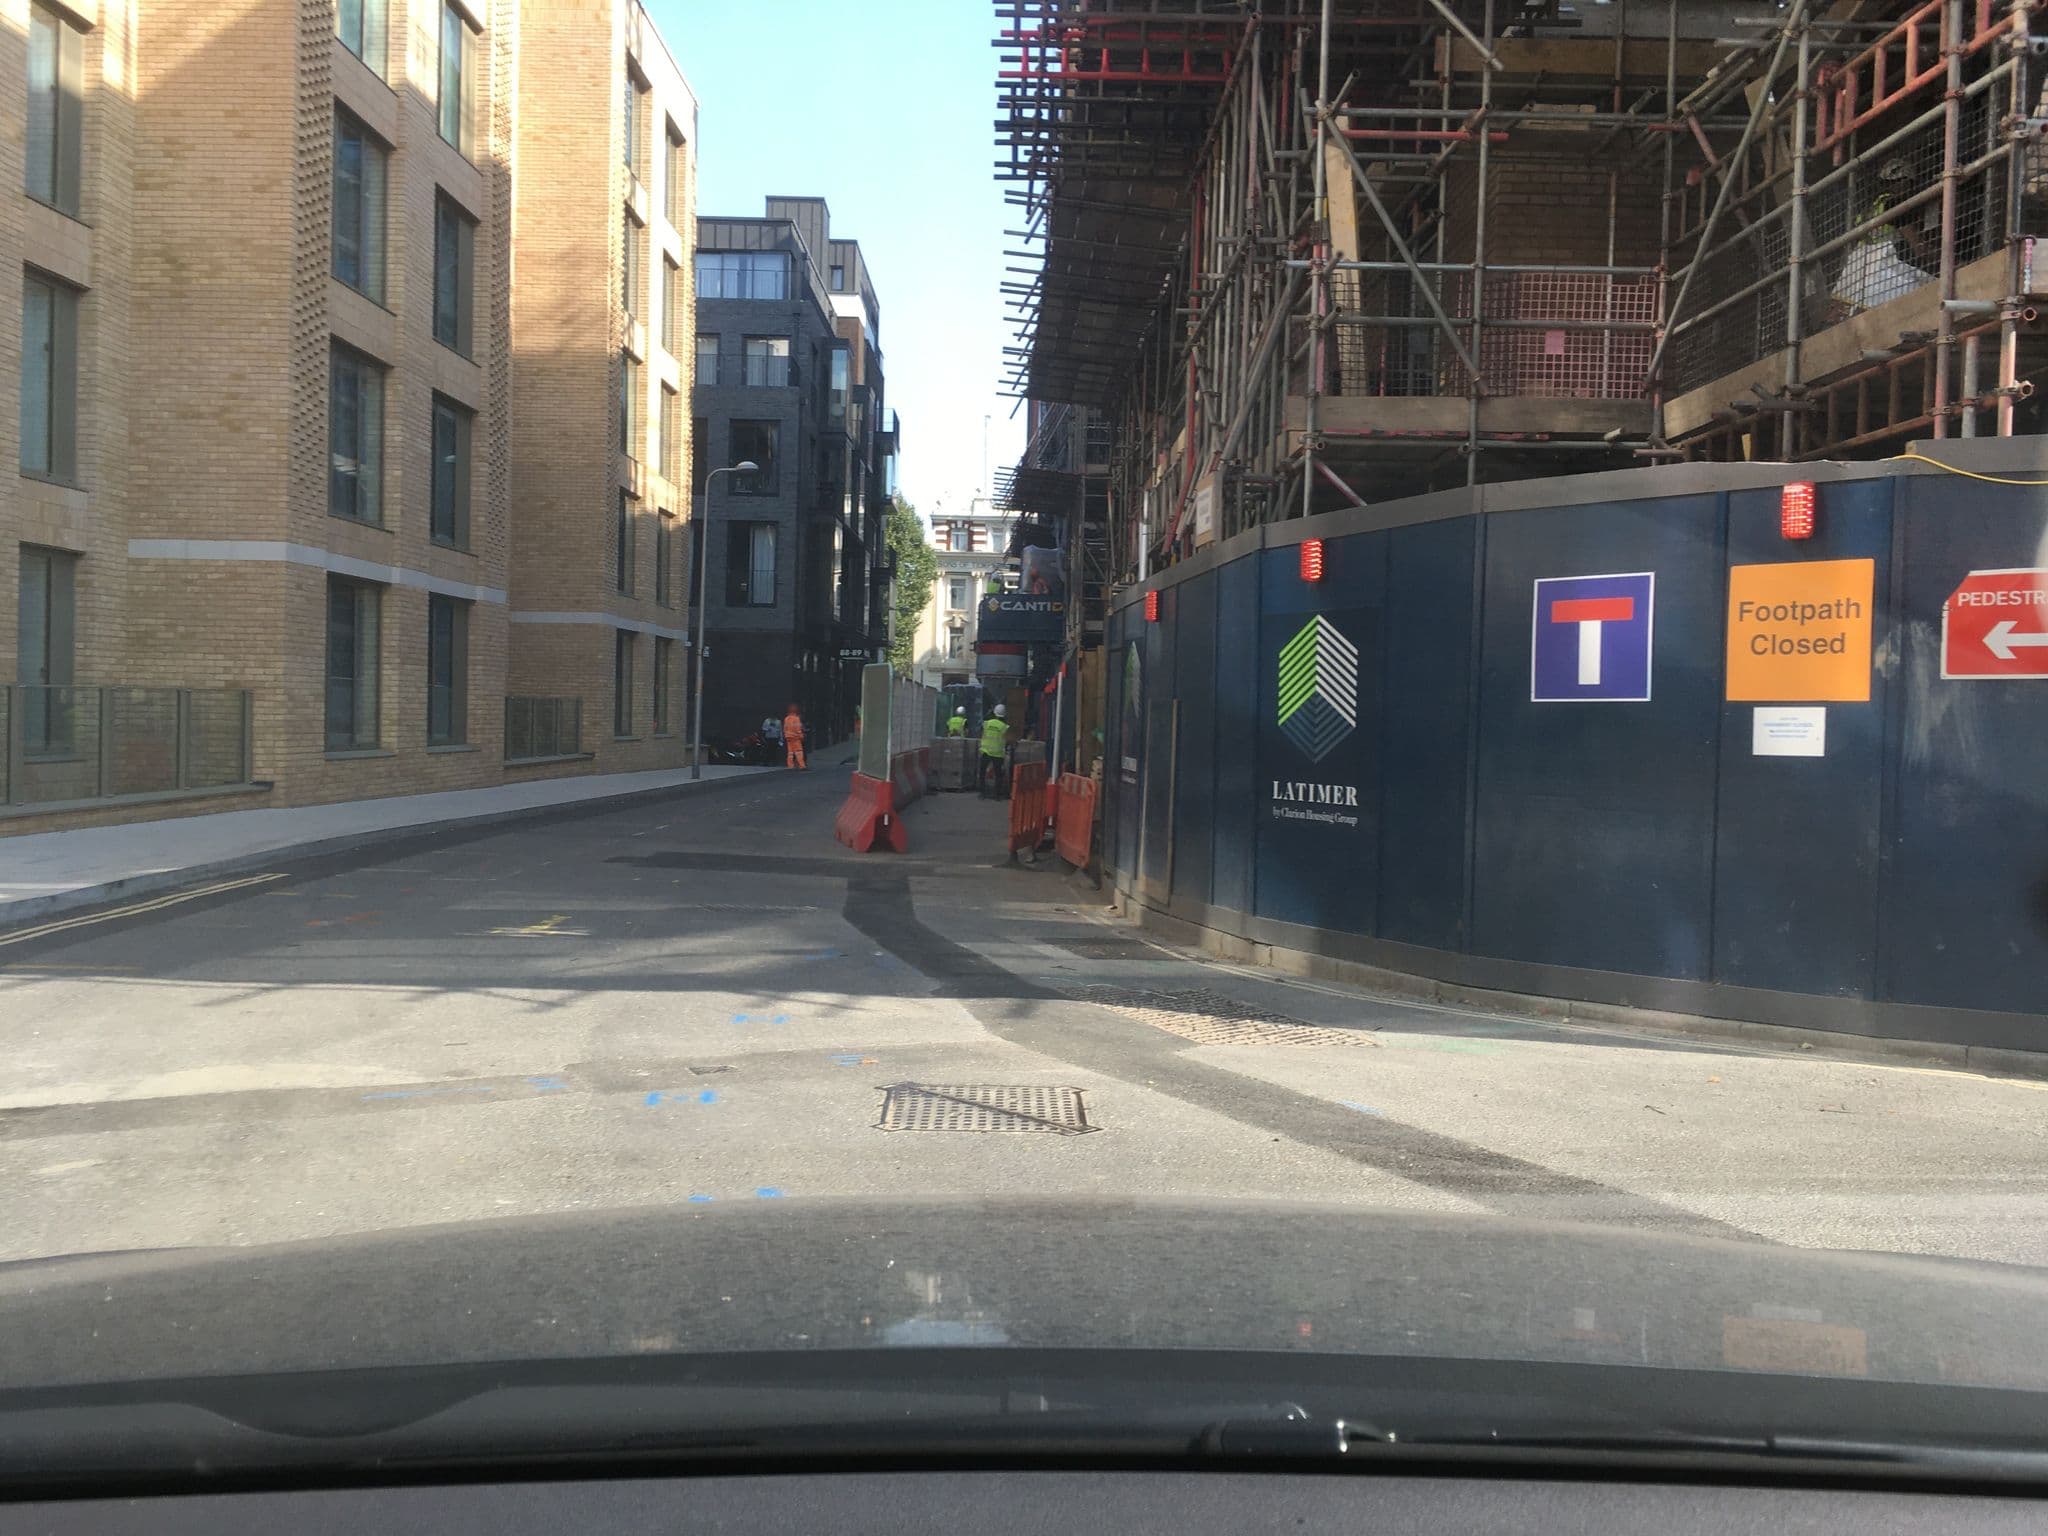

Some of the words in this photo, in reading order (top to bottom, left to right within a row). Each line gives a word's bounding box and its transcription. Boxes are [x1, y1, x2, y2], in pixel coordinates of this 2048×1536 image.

[1738, 598, 1861, 626] Footpath
[1750, 633, 1846, 656] Closed
[1272, 781, 1359, 806] LATIMER
[1273, 806, 1280, 819] by
[1281, 807, 1306, 819] Clarion
[1306, 809, 1335, 824] Housing
[1334, 813, 1359, 827] Group
